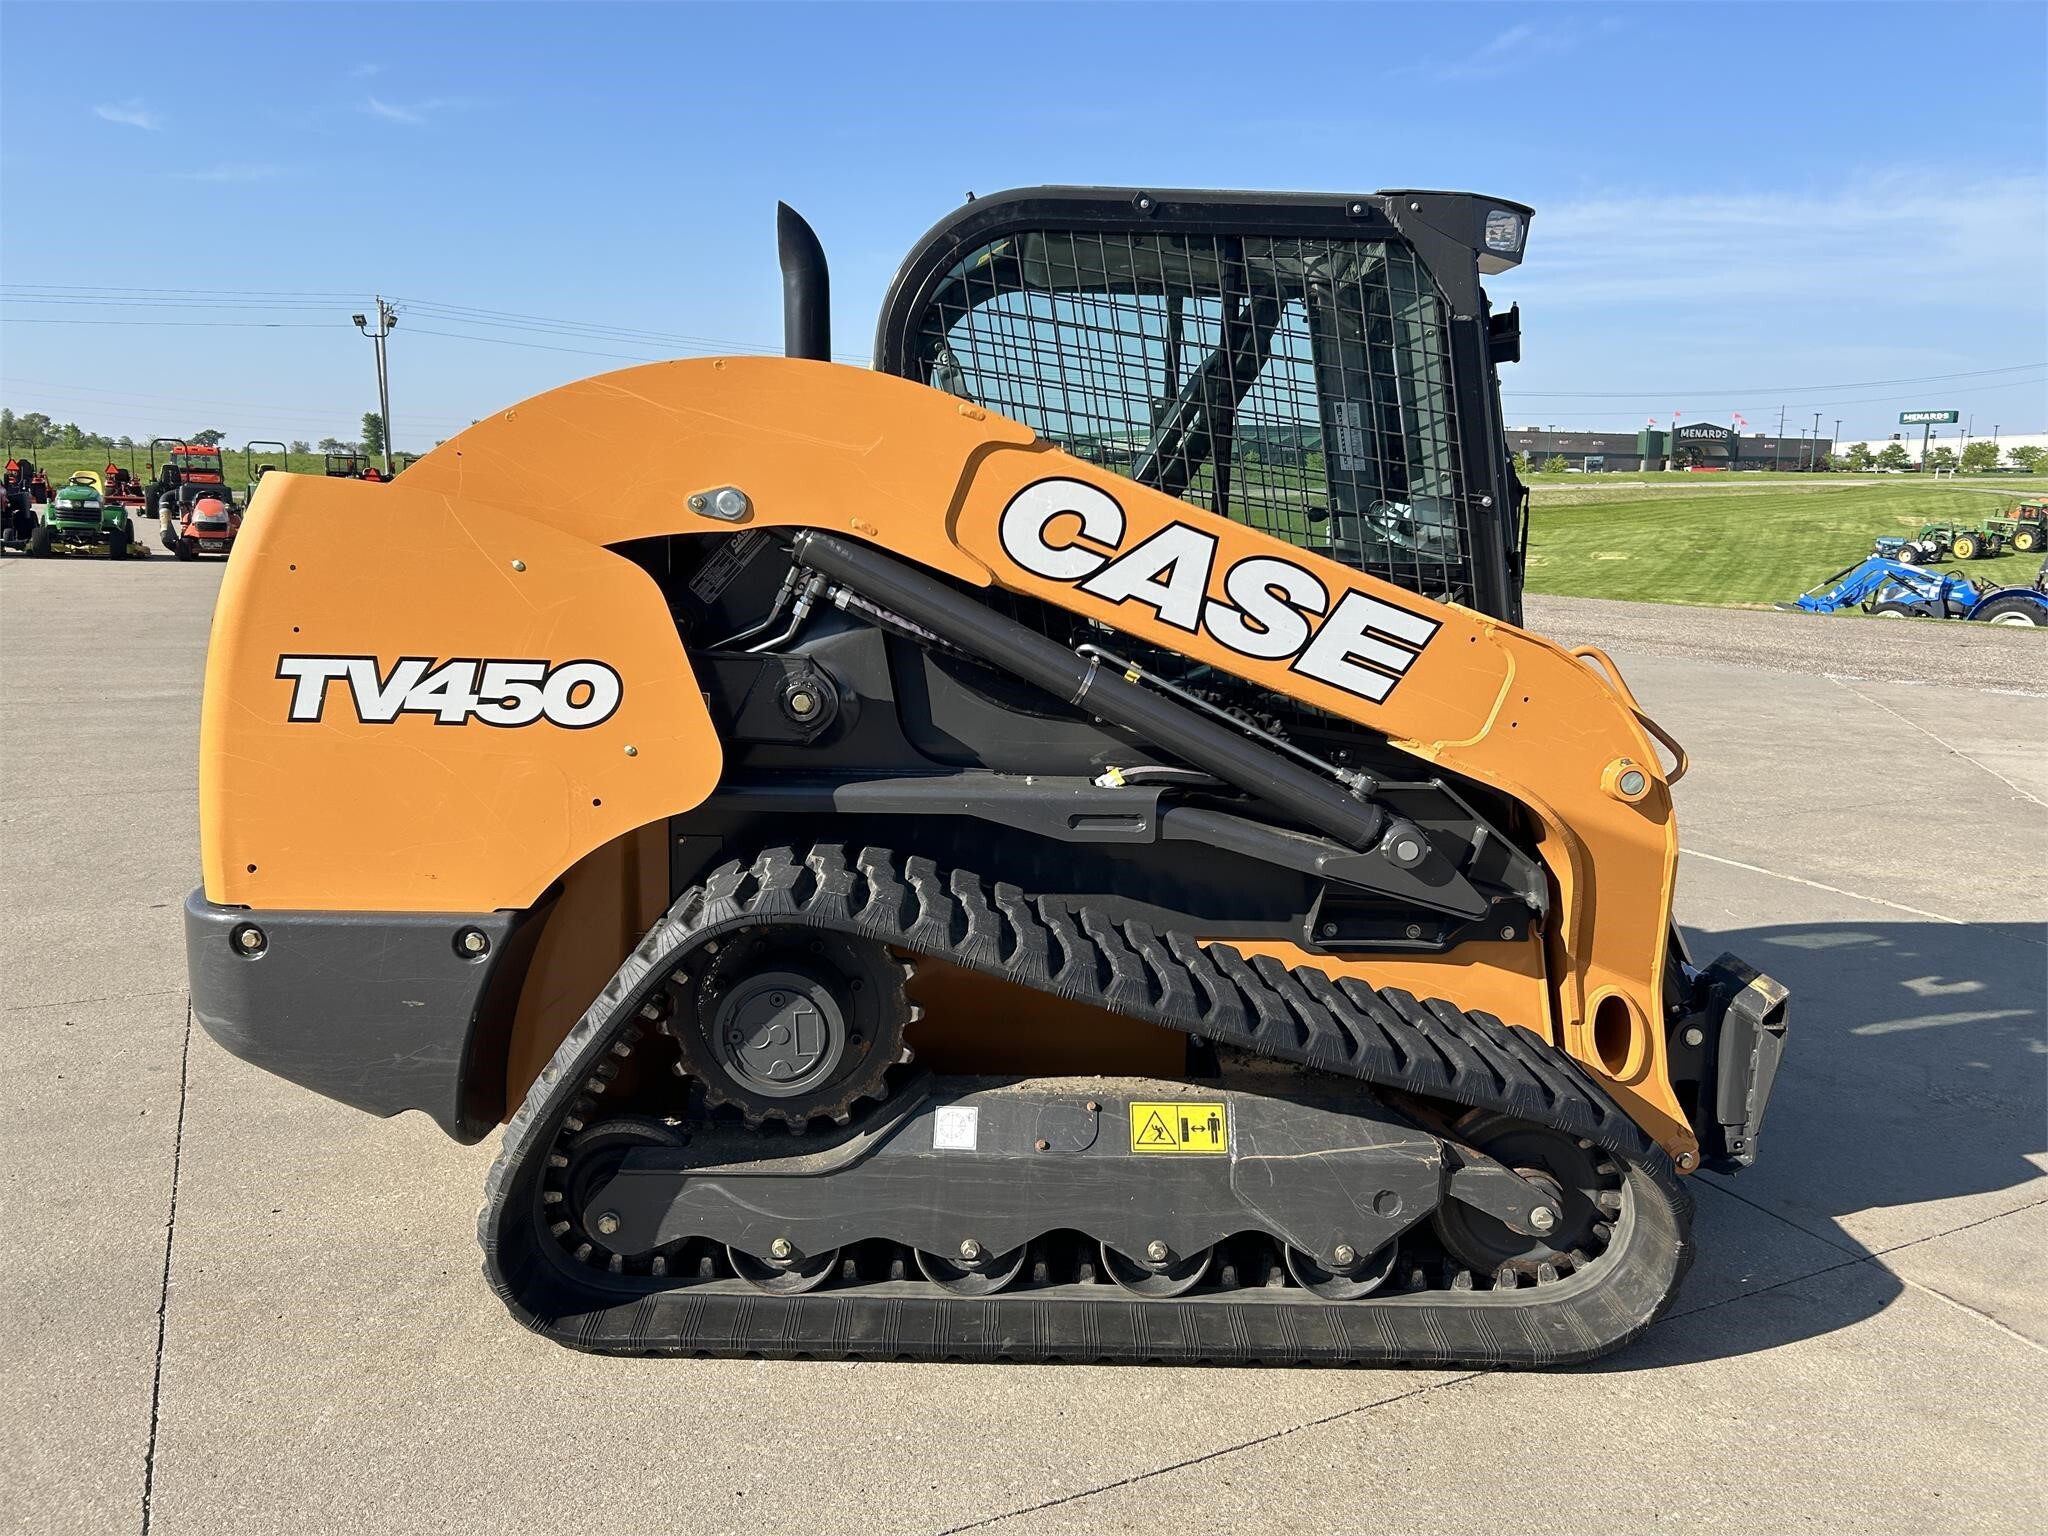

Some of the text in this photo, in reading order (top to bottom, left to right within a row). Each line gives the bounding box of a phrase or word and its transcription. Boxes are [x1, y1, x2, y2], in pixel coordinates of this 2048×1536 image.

[1680, 428, 1728, 439] MENARDS
[1903, 412, 1950, 421] MENARDS
[999, 476, 1444, 705] CASE
[275, 653, 624, 730] TV450
